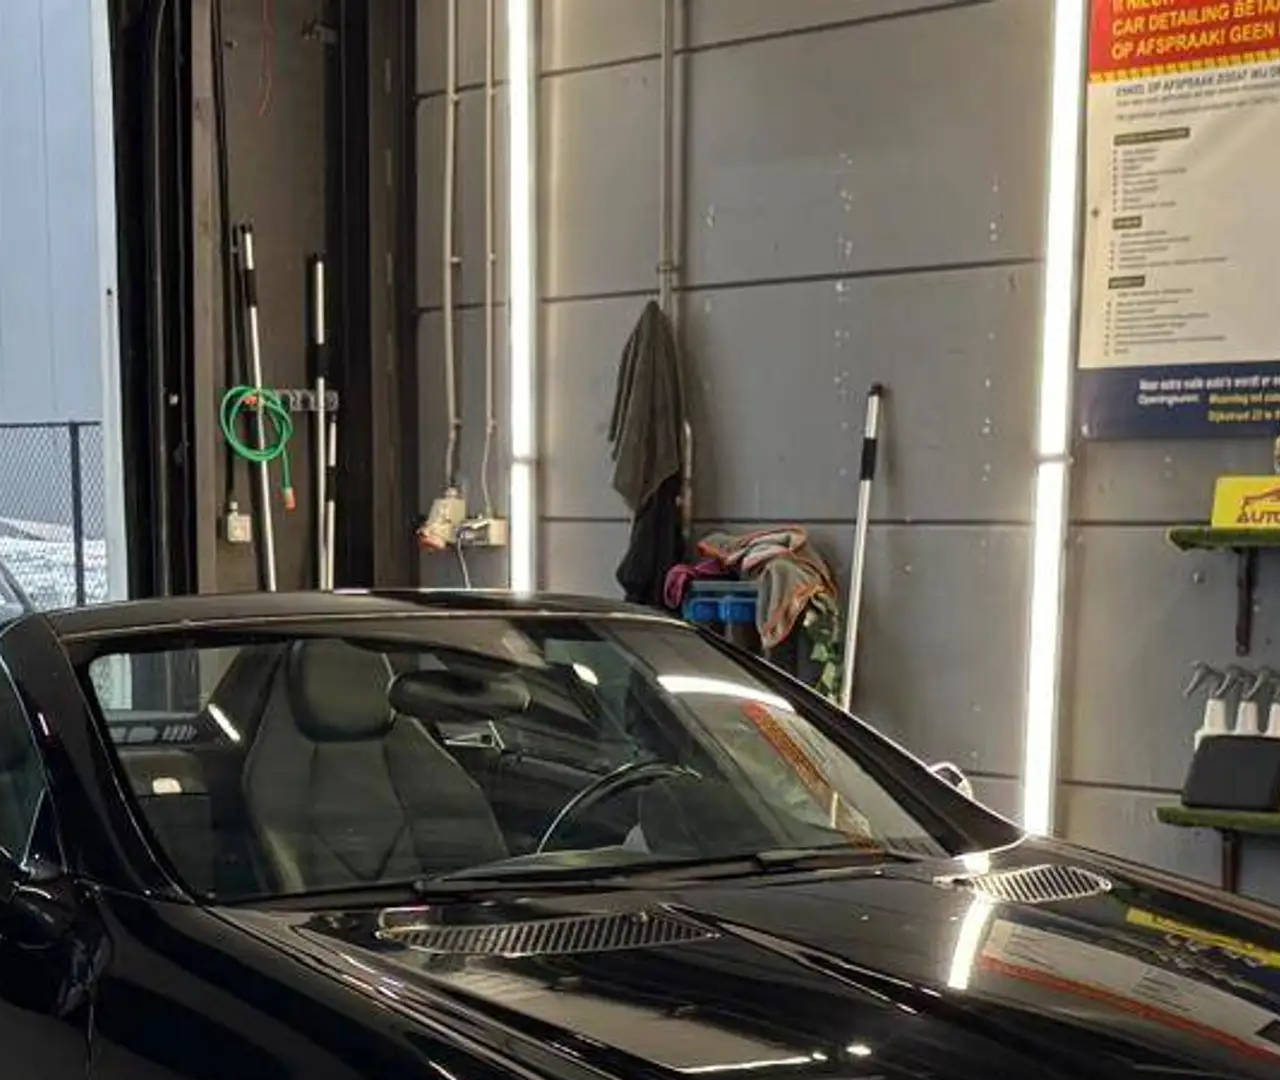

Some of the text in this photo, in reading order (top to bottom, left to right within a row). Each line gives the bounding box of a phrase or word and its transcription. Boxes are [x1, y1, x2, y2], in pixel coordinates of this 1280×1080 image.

[1113, 18, 1145, 36] CAR
[1148, 3, 1229, 31] DETAILING
[1112, 41, 1133, 60] OP
[1230, 24, 1274, 42] GEEN
